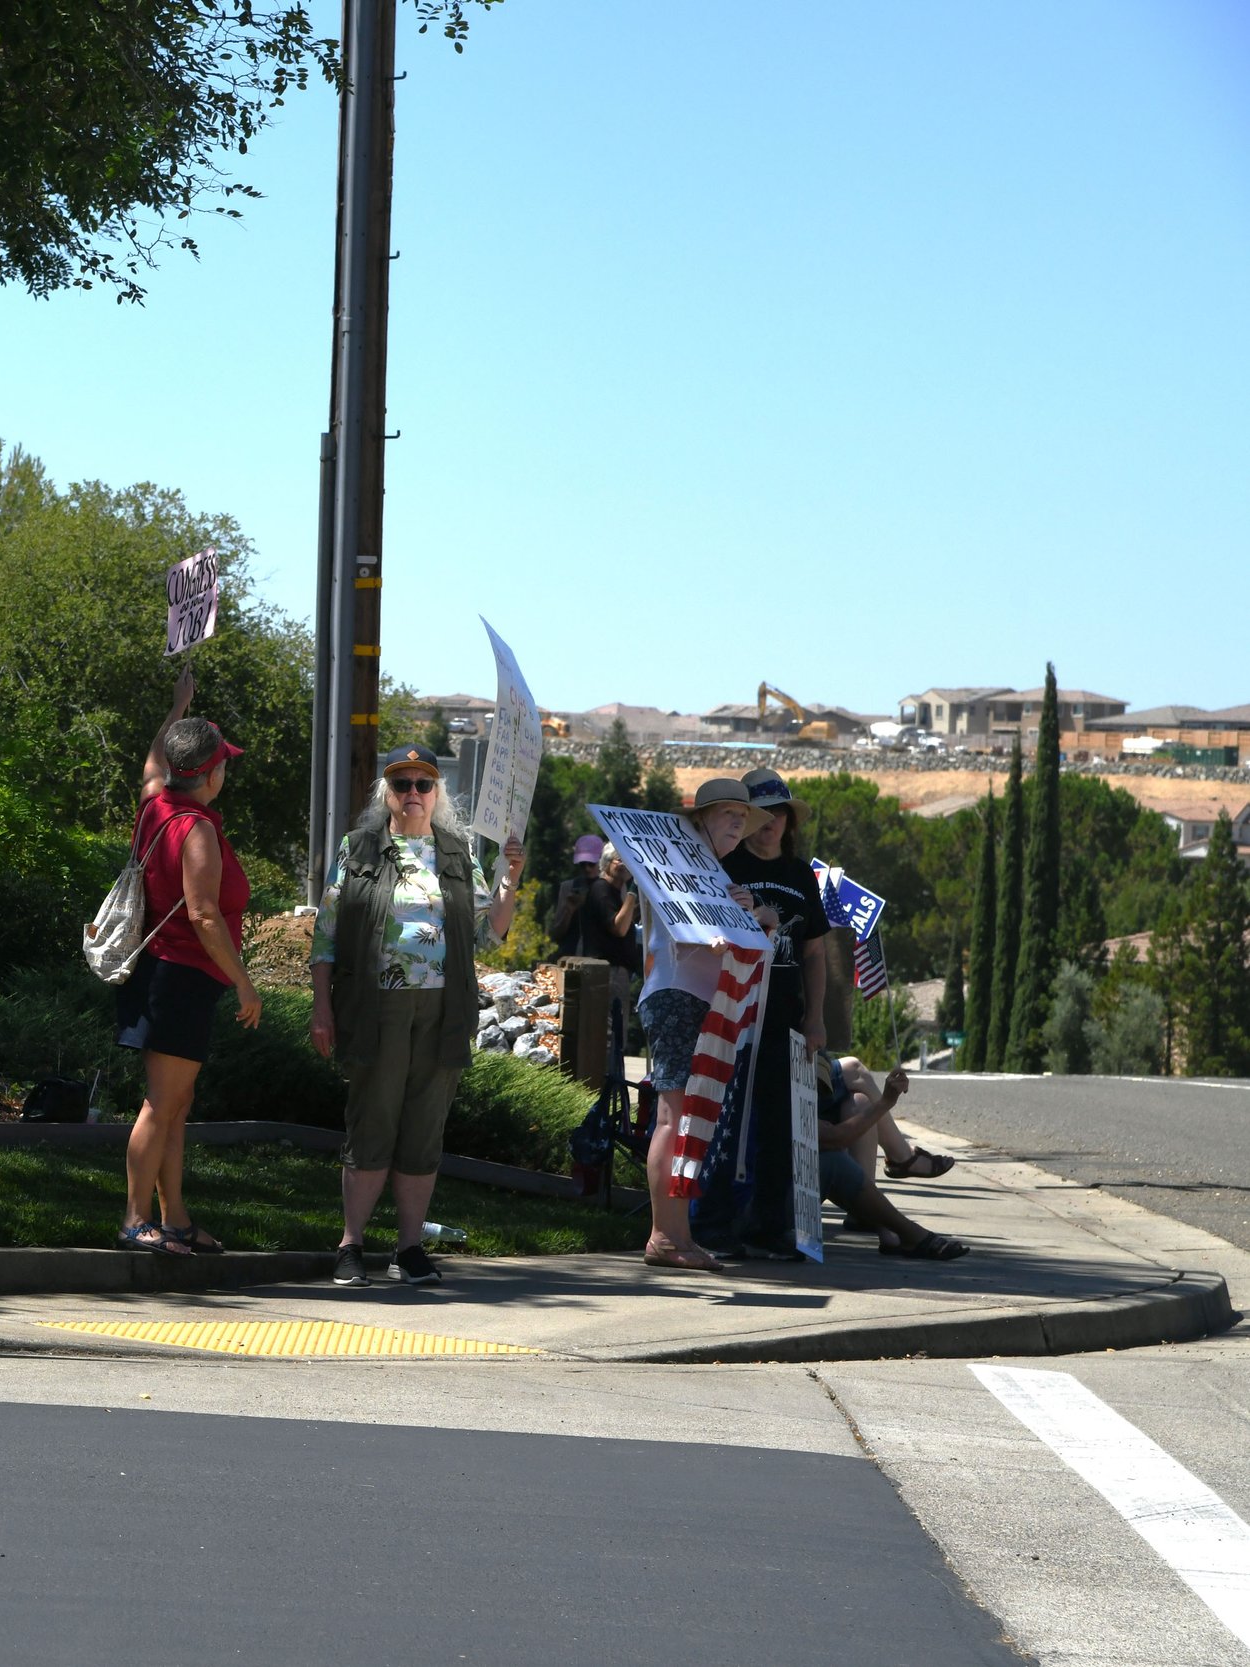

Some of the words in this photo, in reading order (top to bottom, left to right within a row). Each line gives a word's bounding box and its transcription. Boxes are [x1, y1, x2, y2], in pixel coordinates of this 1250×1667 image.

[167, 553, 216, 607] CONGRESS
[167, 599, 213, 653] JOB!
[491, 759, 505, 775] PBS
[483, 807, 499, 828] EPA
[622, 835, 673, 867] STOP
[670, 840, 720, 873] THIS
[644, 866, 727, 898] MADNESS
[750, 881, 764, 890] FOR
[658, 901, 693, 926] JOIN
[687, 902, 762, 932] INDIVISIBLE
